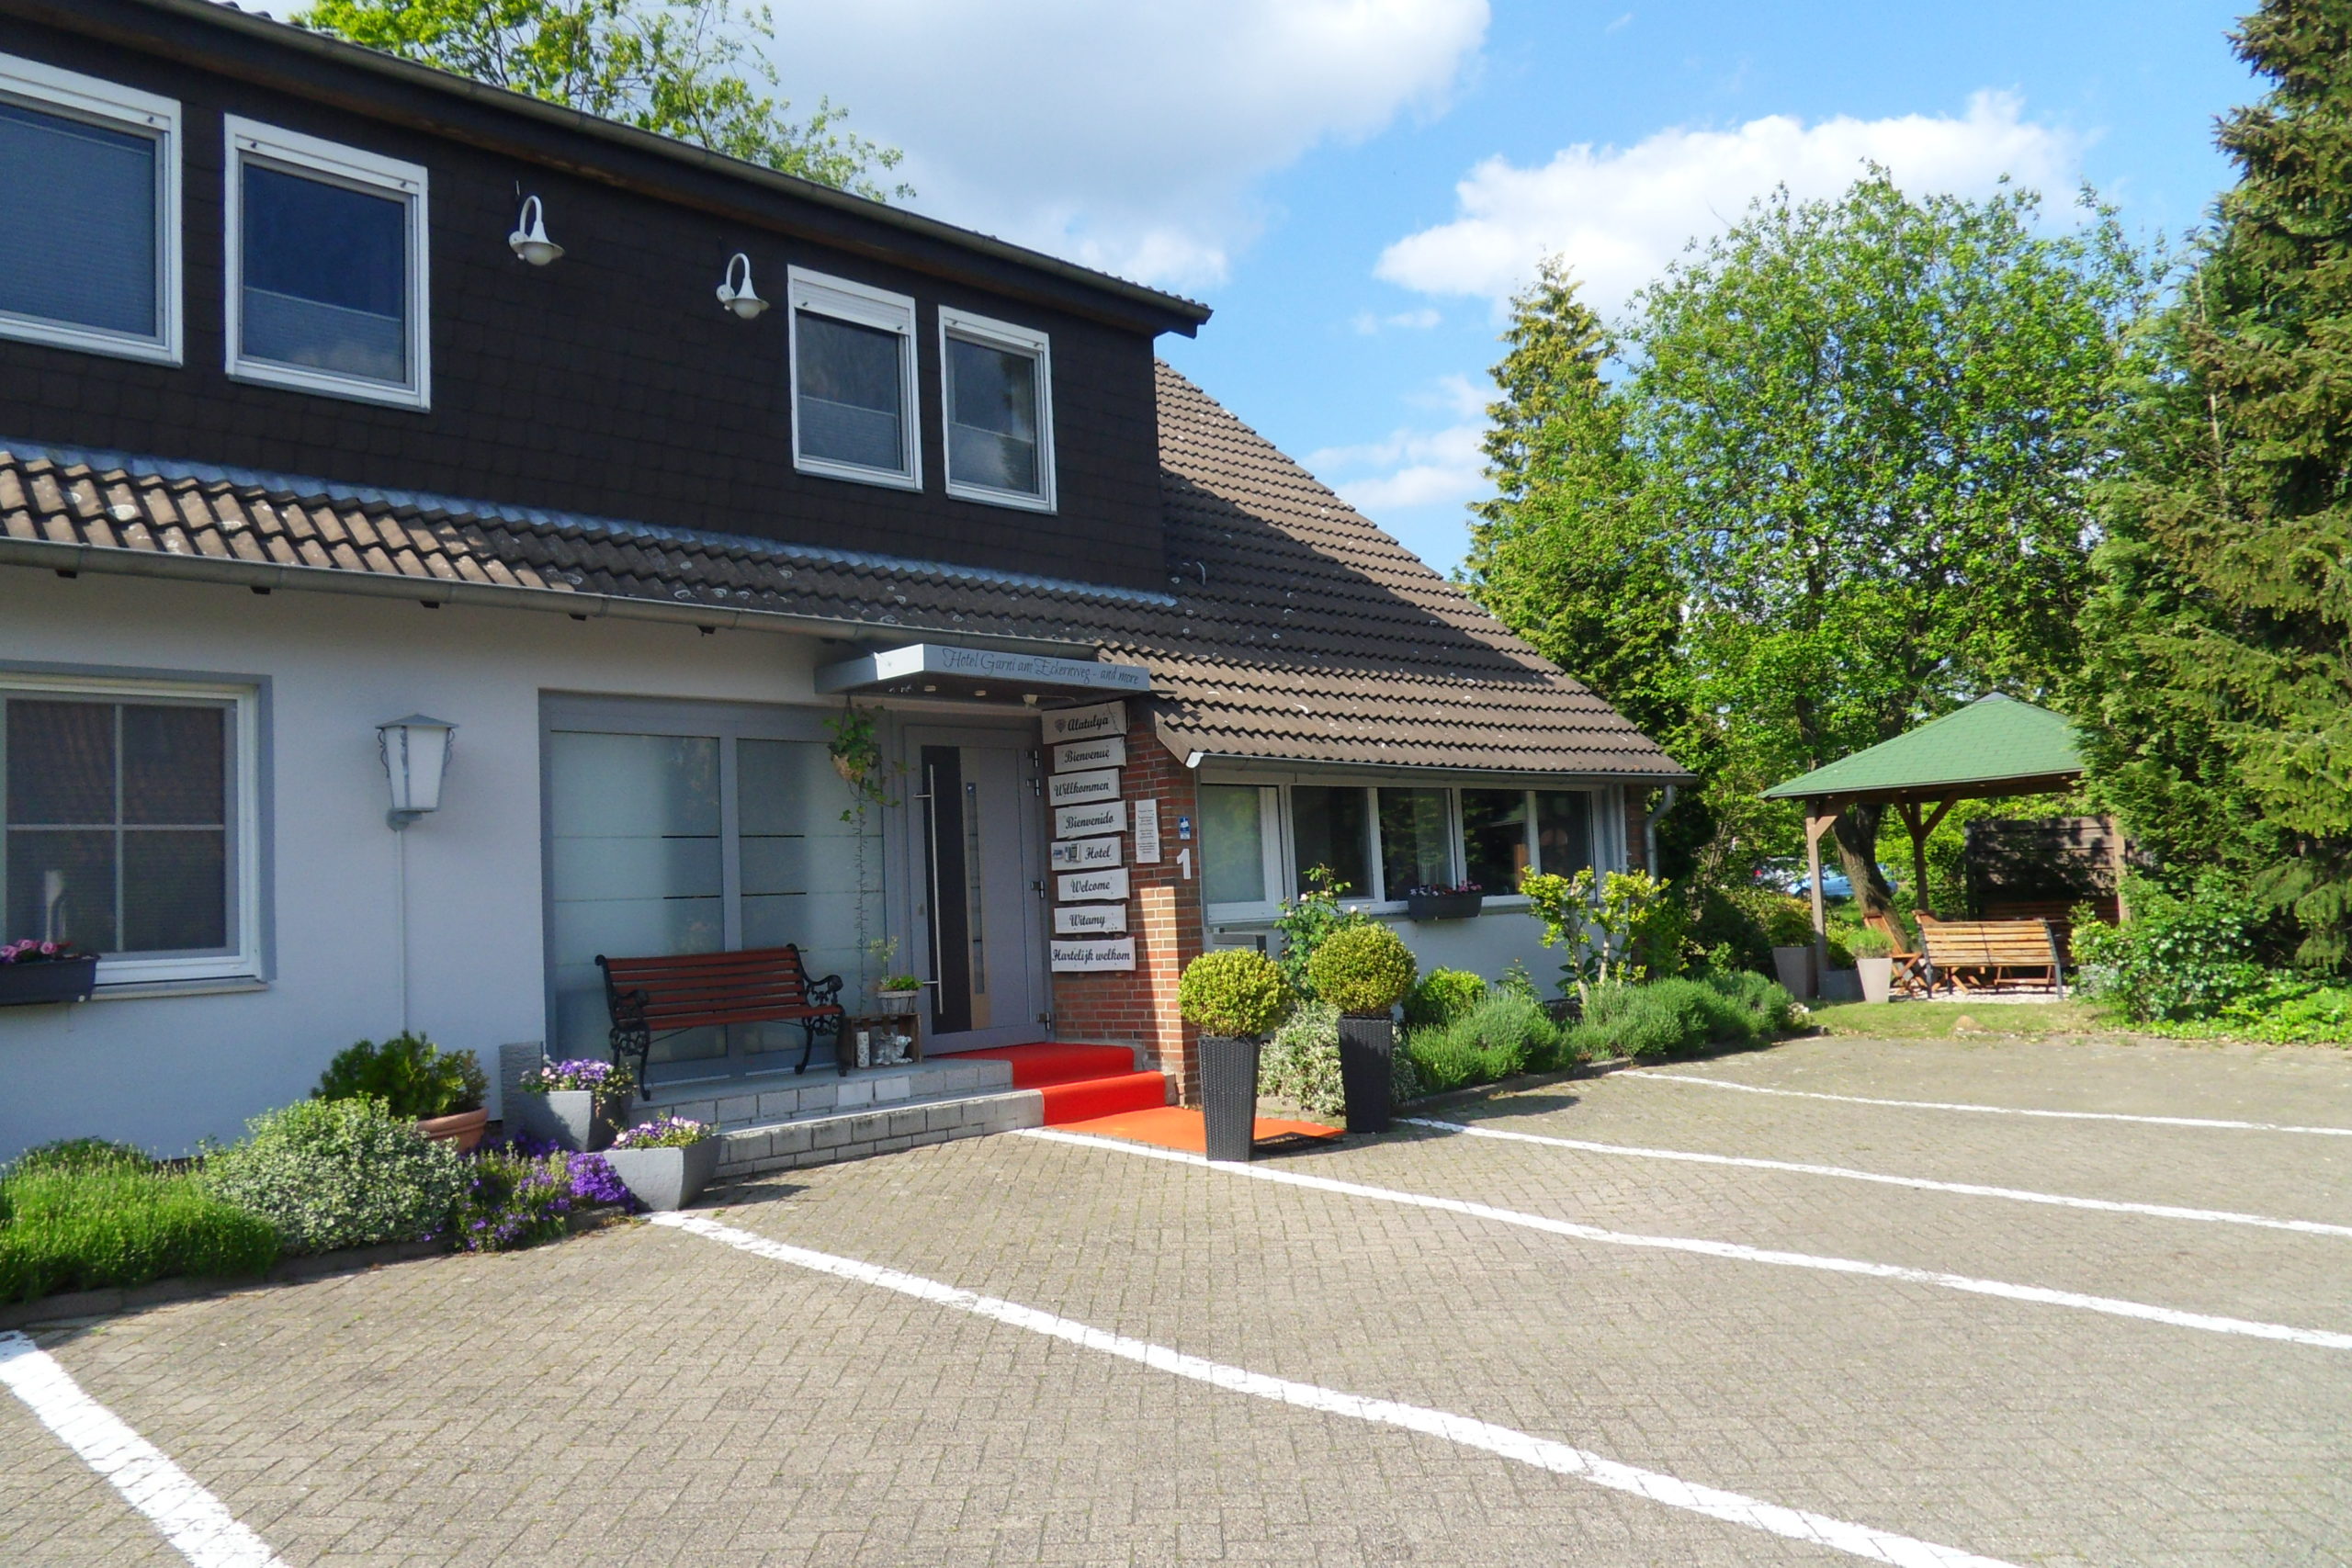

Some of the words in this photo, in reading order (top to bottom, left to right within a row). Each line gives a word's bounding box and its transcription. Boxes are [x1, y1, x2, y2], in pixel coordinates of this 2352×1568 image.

[942, 649, 979, 669] Hotel
[980, 653, 1015, 676] Garni
[1017, 662, 1033, 673] am
[1101, 666, 1117, 681] and
[1118, 671, 1139, 684] more
[1065, 750, 1110, 763] Bienvenue
[1054, 782, 1109, 796] Willkommen
[1066, 810, 1114, 829] Bienvenido
[1085, 844, 1112, 860] Hotel
[1177, 848, 1191, 879] 1
[1070, 879, 1110, 893] Welcome
[1069, 914, 1105, 928] Witamy
[1052, 949, 1093, 964] Hartelijk
[1095, 948, 1130, 961] welkom
